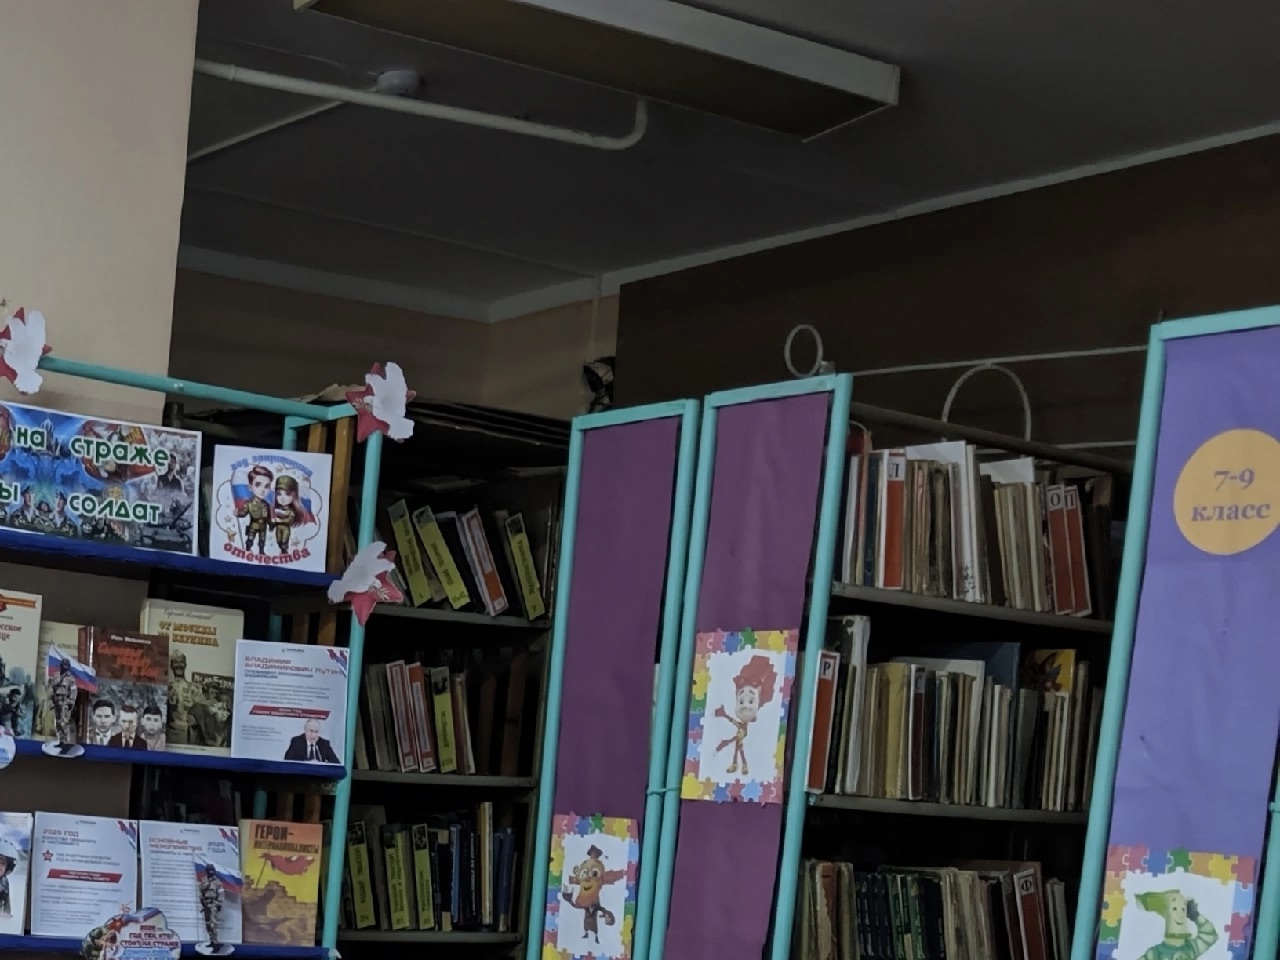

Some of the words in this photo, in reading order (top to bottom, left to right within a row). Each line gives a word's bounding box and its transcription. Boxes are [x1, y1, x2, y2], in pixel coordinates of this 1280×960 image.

[16, 425, 46, 447] на
[70, 437, 170, 467] страже
[1214, 469, 1255, 492] 7-9
[69, 494, 161, 524] солдат
[1191, 503, 1271, 522] класс
[223, 542, 312, 565] отечества
